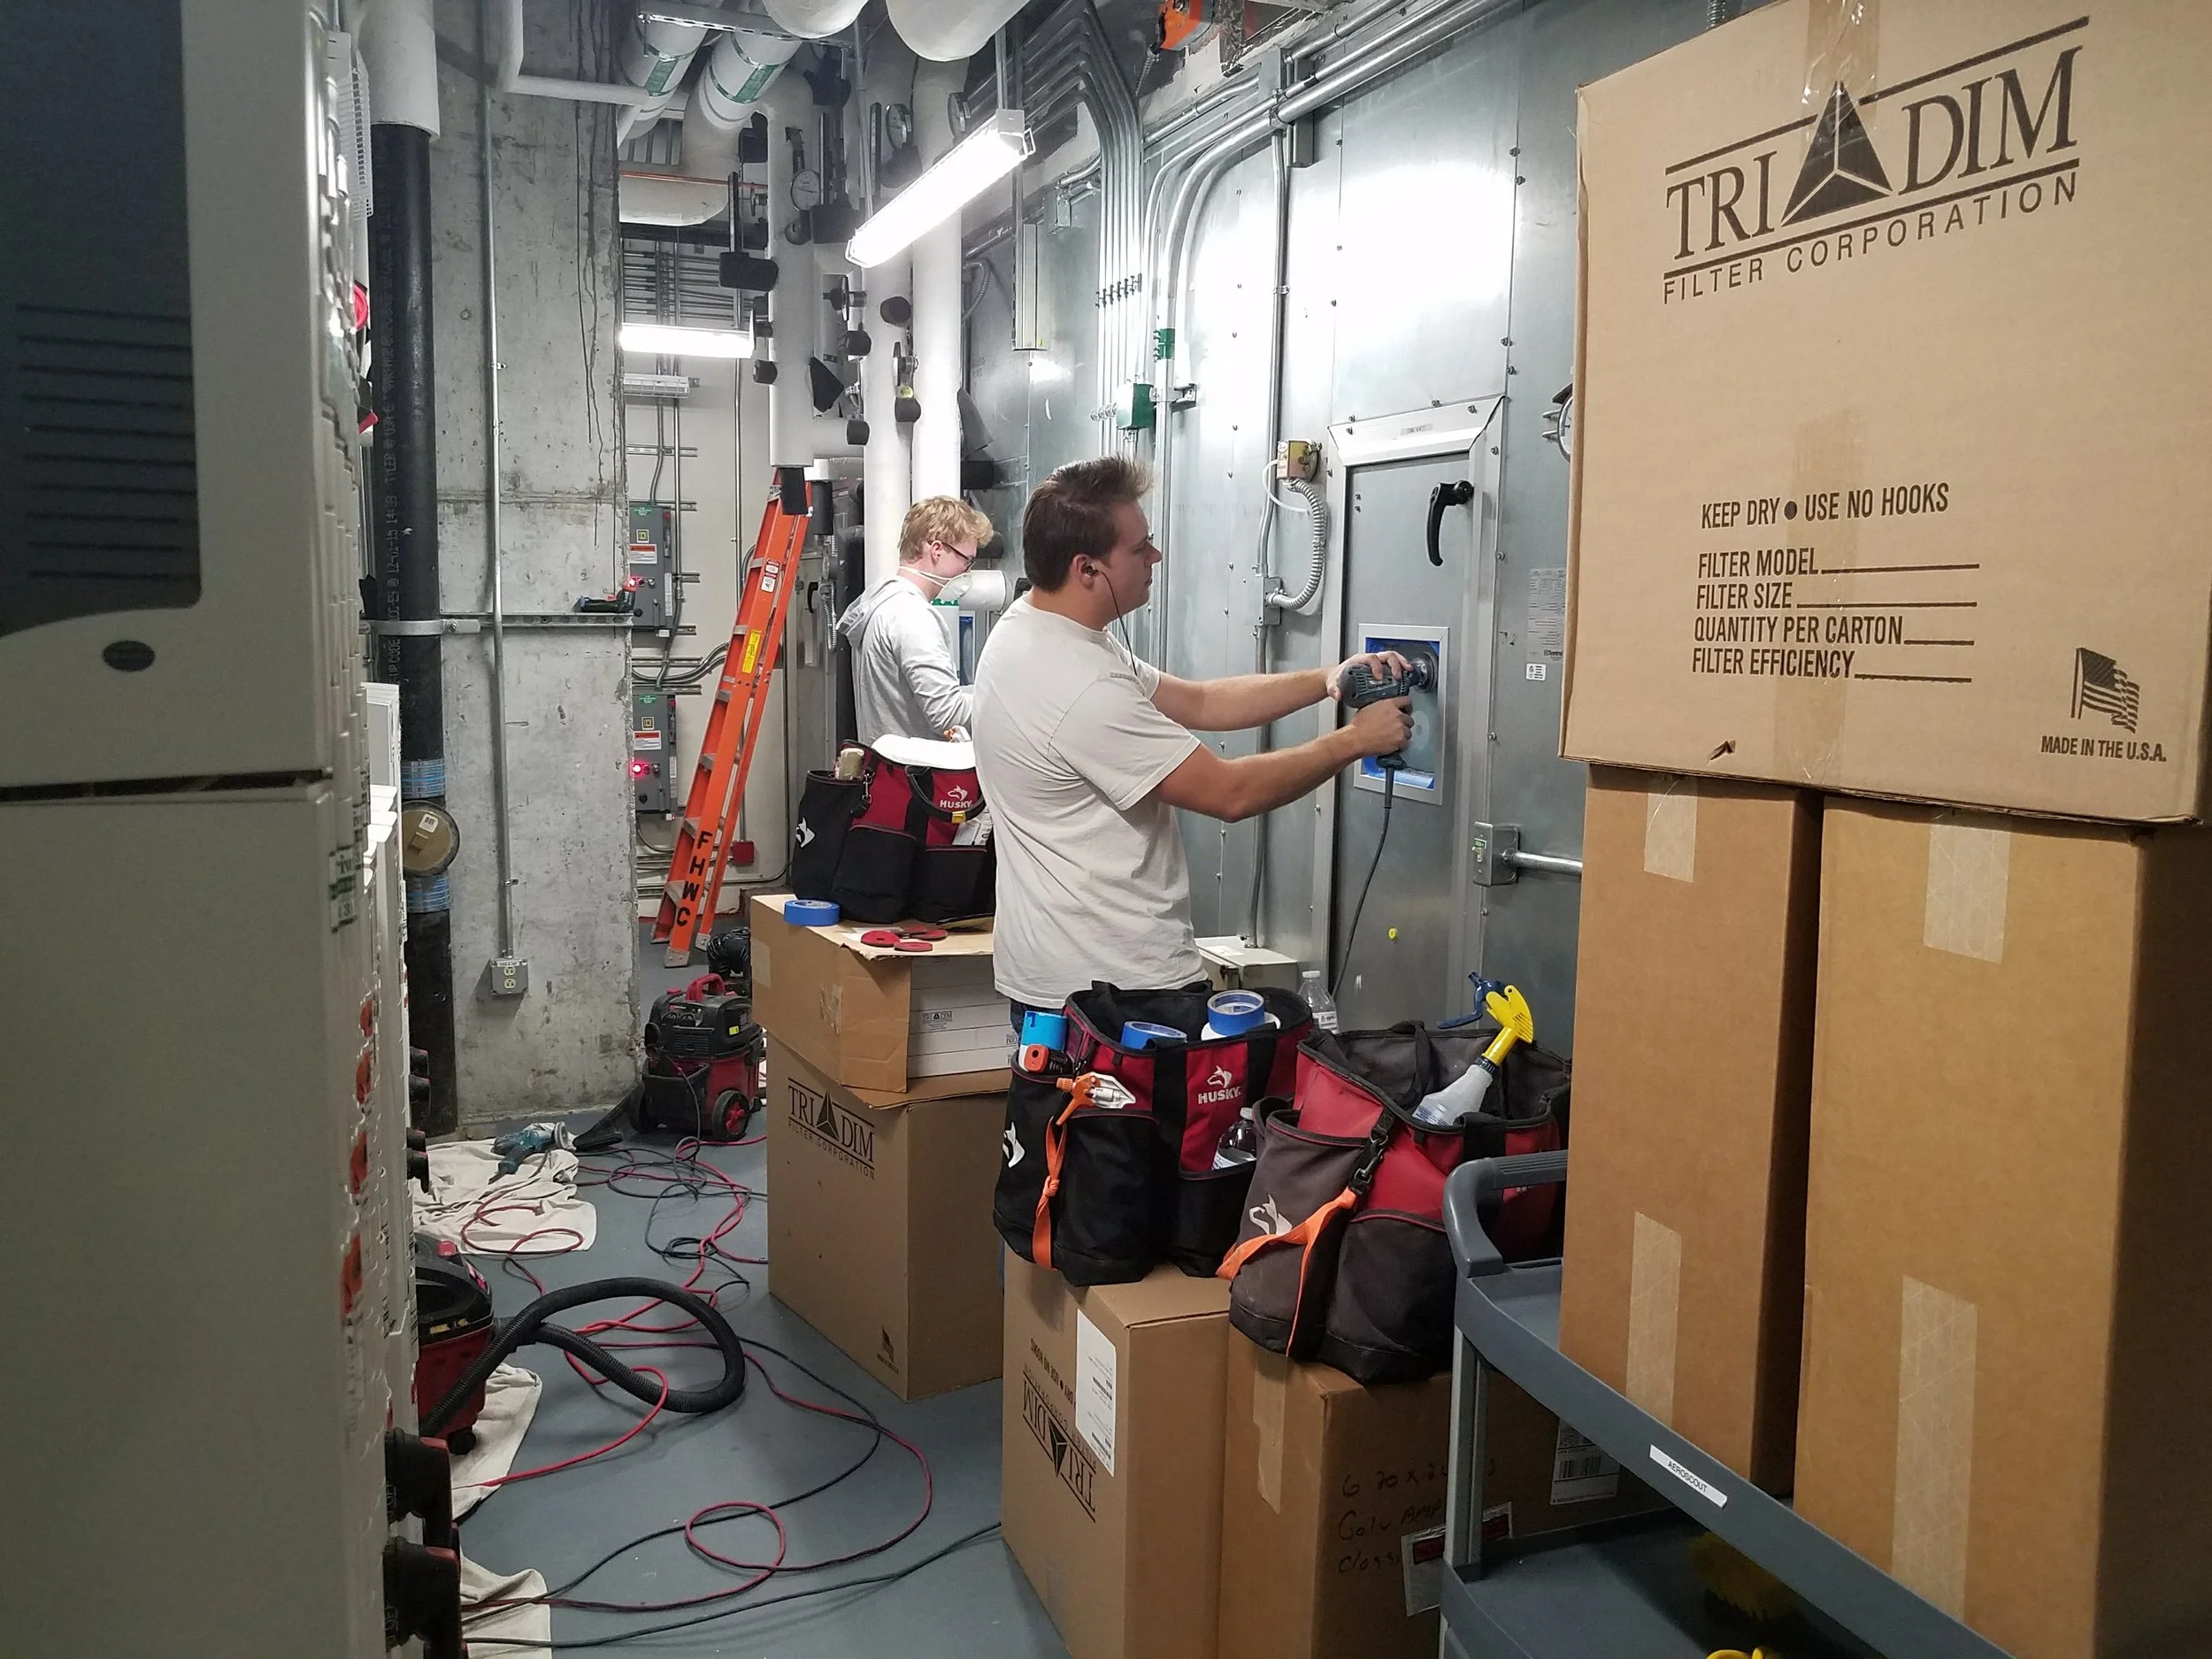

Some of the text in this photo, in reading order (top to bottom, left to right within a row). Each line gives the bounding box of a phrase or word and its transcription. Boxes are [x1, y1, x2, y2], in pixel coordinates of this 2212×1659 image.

[1664, 43, 2084, 260] TRI DIM
[1663, 171, 2078, 305] FILTER CORPORATION
[1701, 482, 1949, 529] KEEP DRY USE NO HOOKS
[1698, 547, 1819, 579] FILTER MODEL
[1696, 581, 1793, 610] FILTER SIZE
[1694, 616, 1903, 645] QUANTITY PER CARTON
[1692, 648, 1855, 679] FILTER EFFICIENCY
[2040, 735, 2167, 762] MADE IN THE U.S.A.
[939, 799, 972, 810] HUSKY
[1198, 1085, 1240, 1105] HUSKY
[787, 1085, 874, 1164] TRI DIM
[788, 1121, 875, 1181] FILTER CORPORATION
[1667, 1460, 1708, 1493] AEROSCOUT
